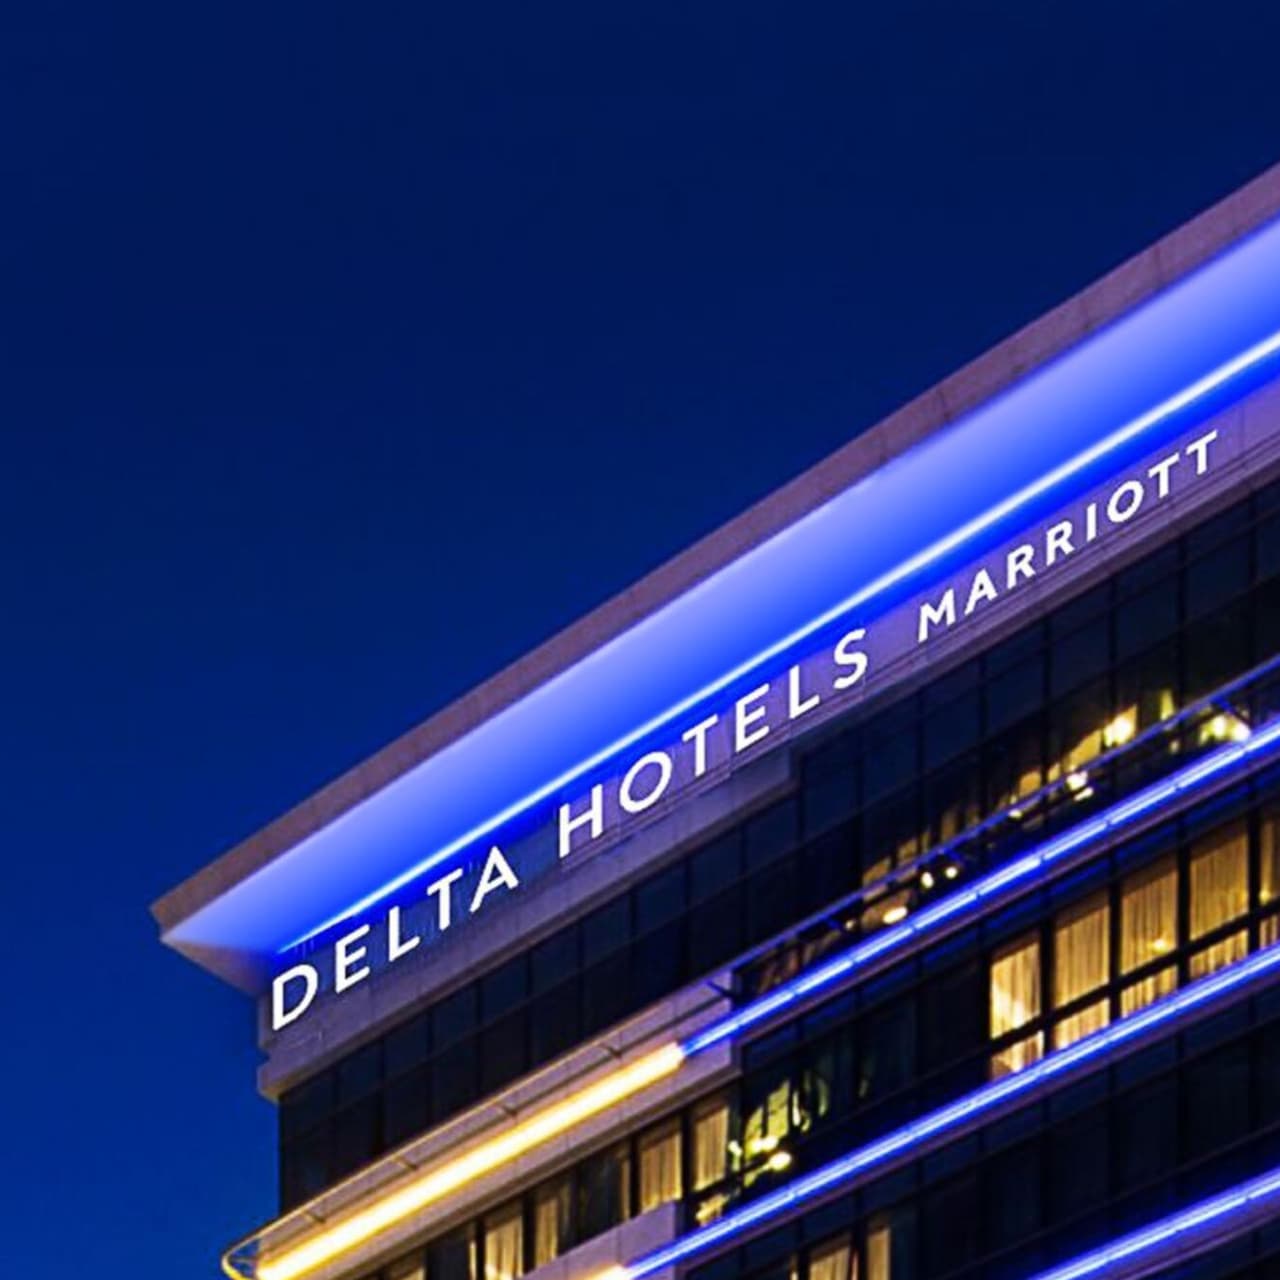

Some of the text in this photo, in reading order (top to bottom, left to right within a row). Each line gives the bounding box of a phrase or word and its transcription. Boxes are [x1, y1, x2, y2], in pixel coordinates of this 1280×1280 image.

[272, 429, 1219, 1031] DELTA HOTELS MARRIOTT
